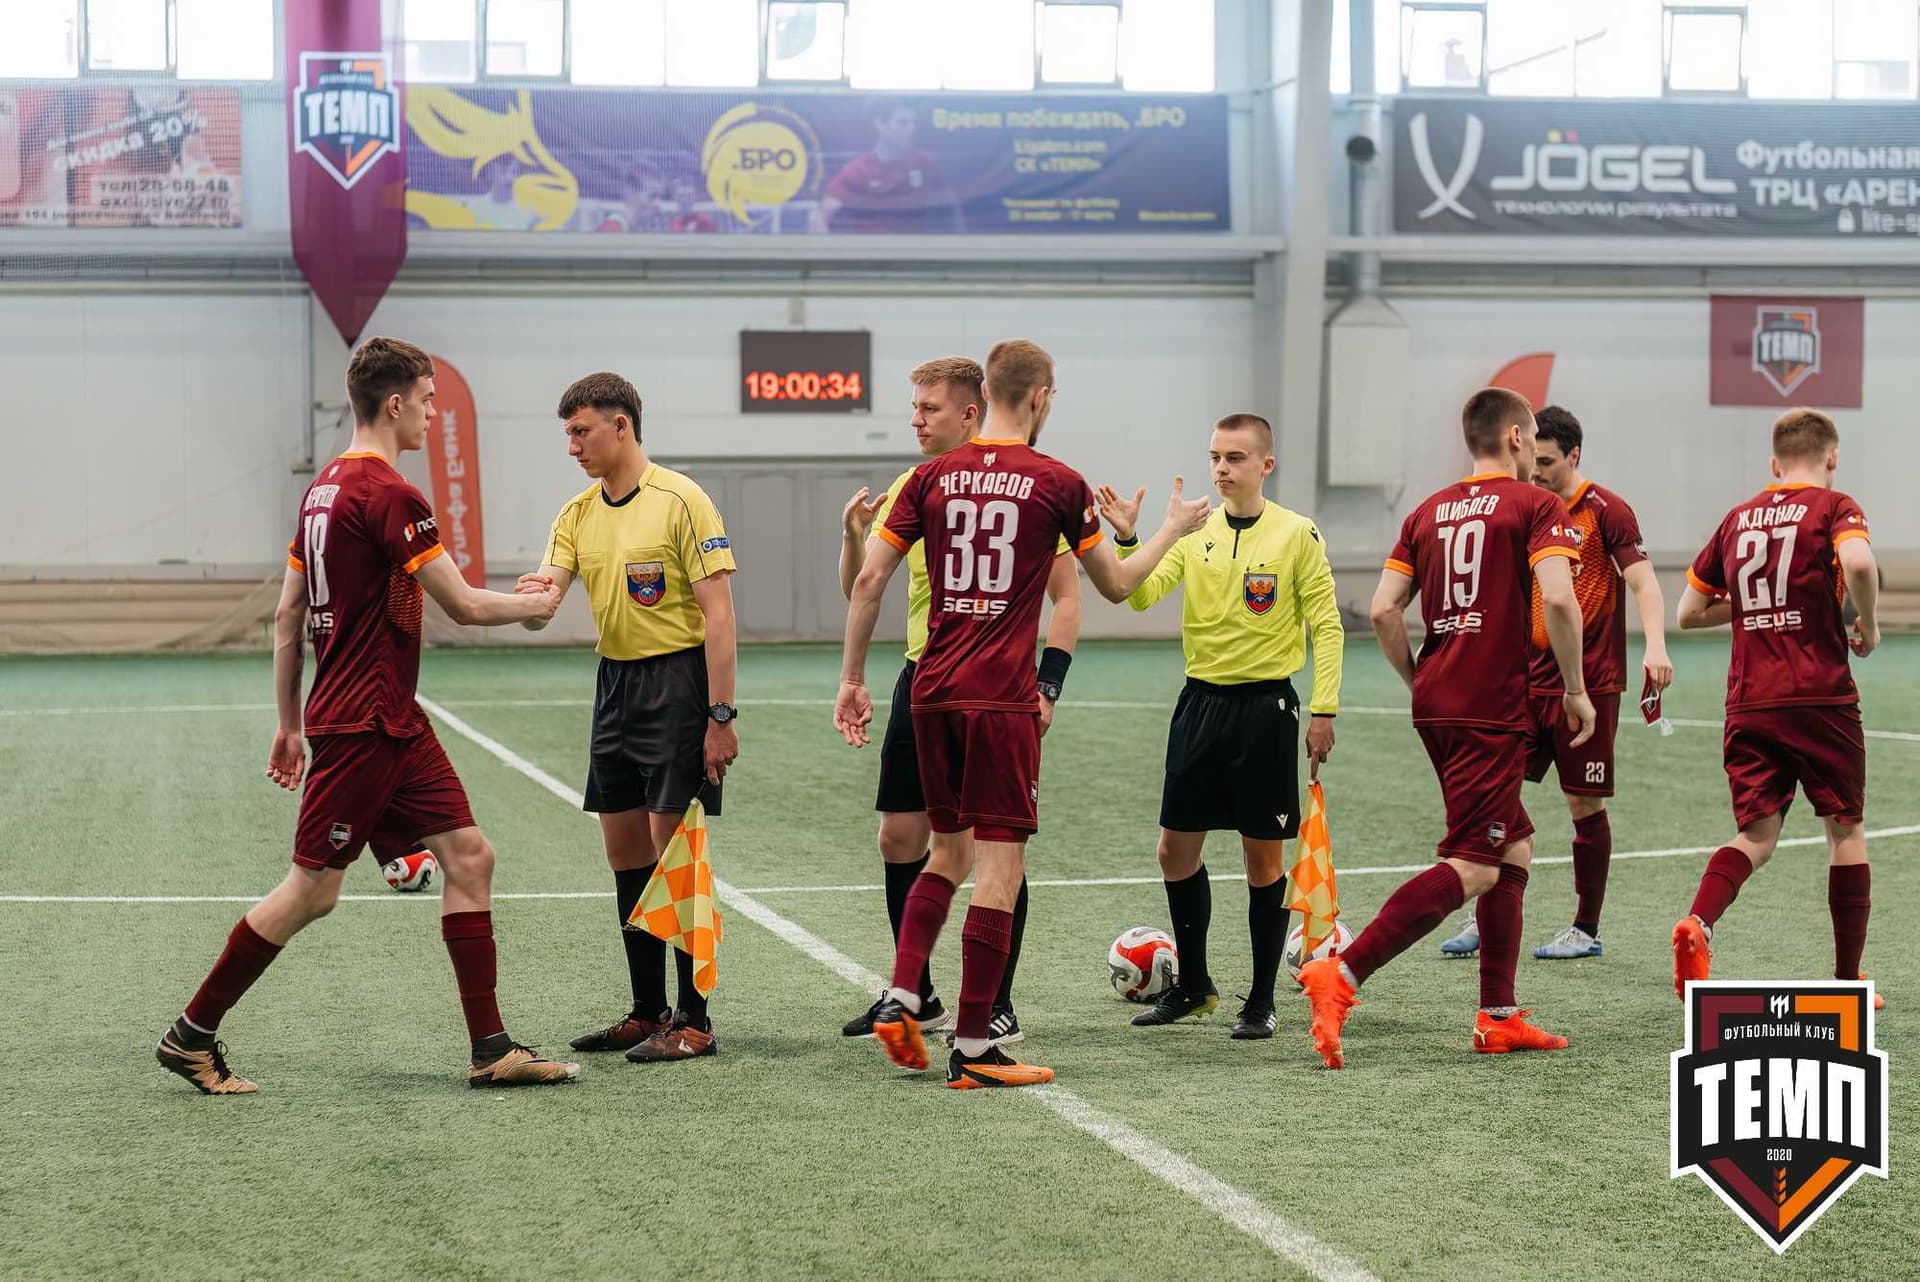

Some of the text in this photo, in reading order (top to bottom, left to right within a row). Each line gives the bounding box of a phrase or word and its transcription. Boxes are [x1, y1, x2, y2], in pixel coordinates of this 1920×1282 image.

[304, 88, 390, 138] ТЕМП
[732, 148, 797, 171] .БРО
[1490, 130, 1738, 193] JÖGEL
[1751, 178, 1819, 211] ТРЦ
[1760, 330, 1814, 364] ТЕМП
[745, 371, 862, 400] 19:00:34
[939, 470, 1035, 500] ЧЕРКАСОВ
[1435, 494, 1500, 523] ШИБАЕВ
[1737, 503, 1808, 531] ЖДАНОВ
[304, 512, 331, 607] 18
[944, 498, 1020, 593] 33
[1437, 519, 1486, 611] 19
[1736, 524, 1798, 612] 27
[942, 597, 1009, 615] SEUS
[1743, 610, 1802, 631] SEUS
[1585, 761, 1606, 783] 23
